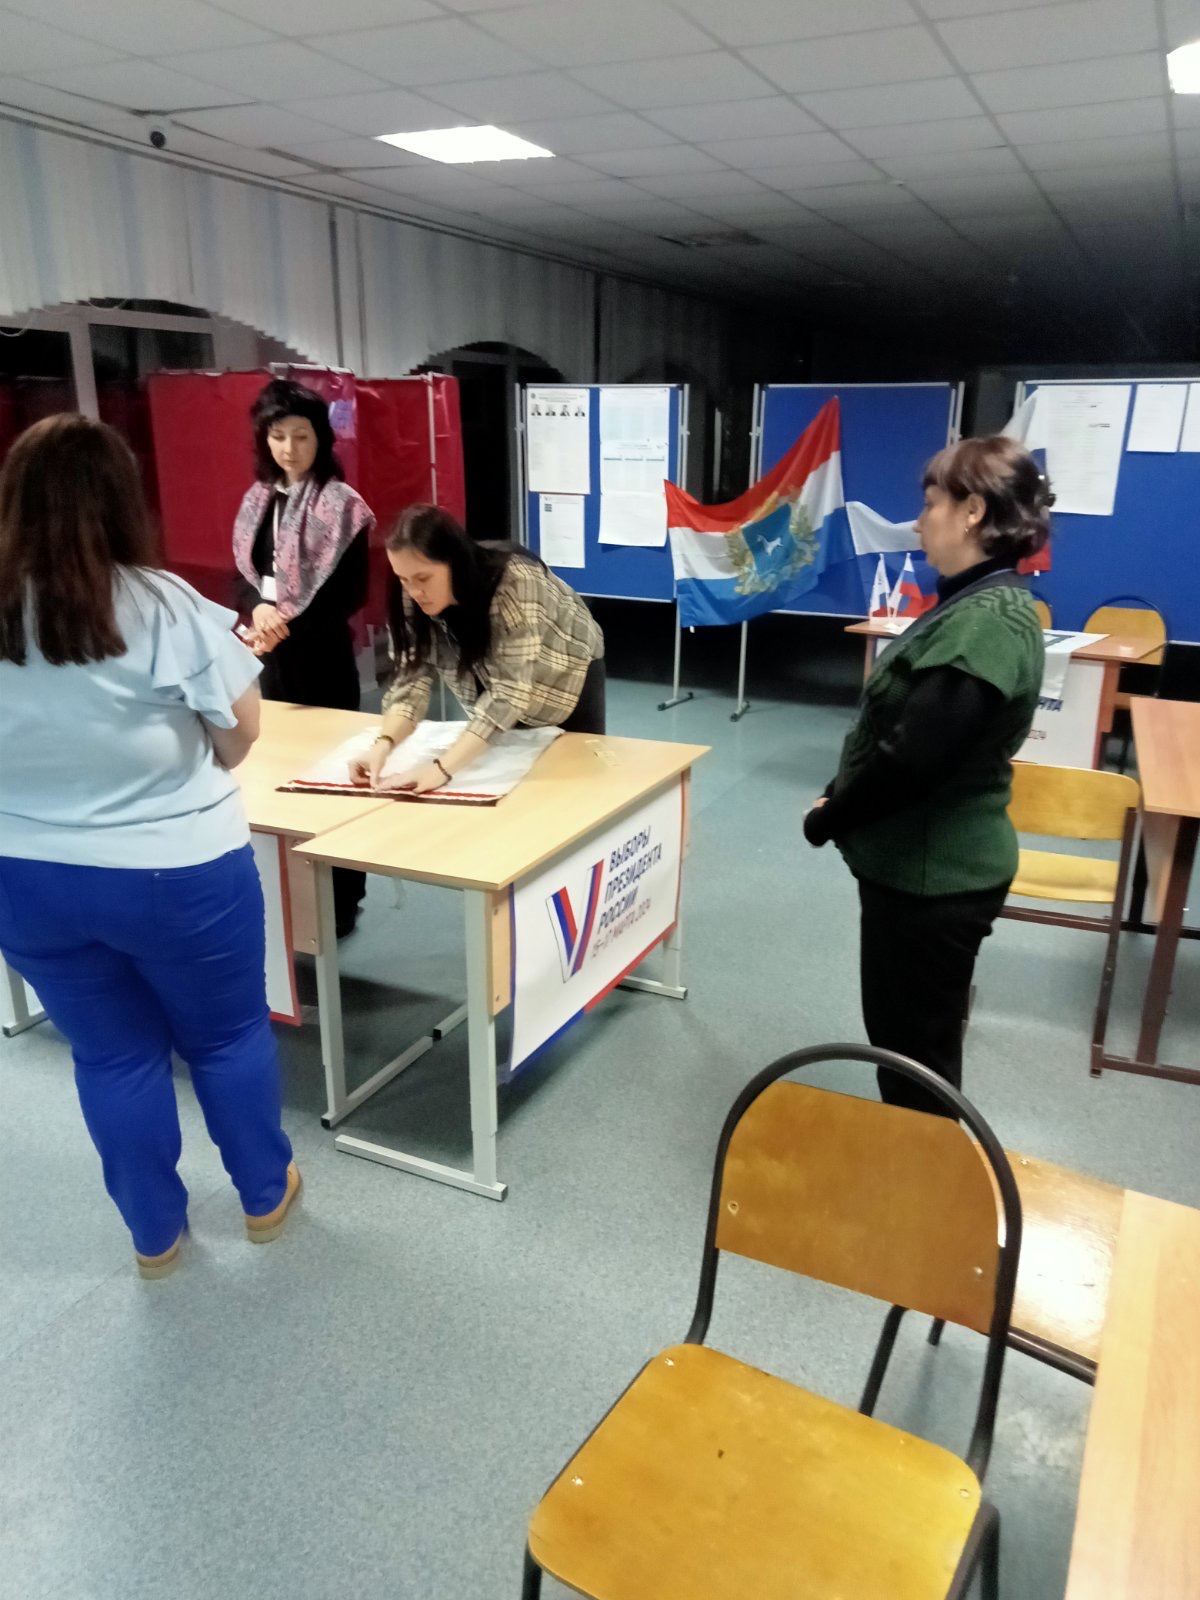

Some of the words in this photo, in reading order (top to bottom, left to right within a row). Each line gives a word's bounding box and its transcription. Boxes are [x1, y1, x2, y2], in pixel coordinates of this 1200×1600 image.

[604, 842, 662, 904] ПРЕЗИДЕНТА
[609, 825, 651, 873] ВЫБОРЫ
[597, 885, 638, 934] РОССИИ
